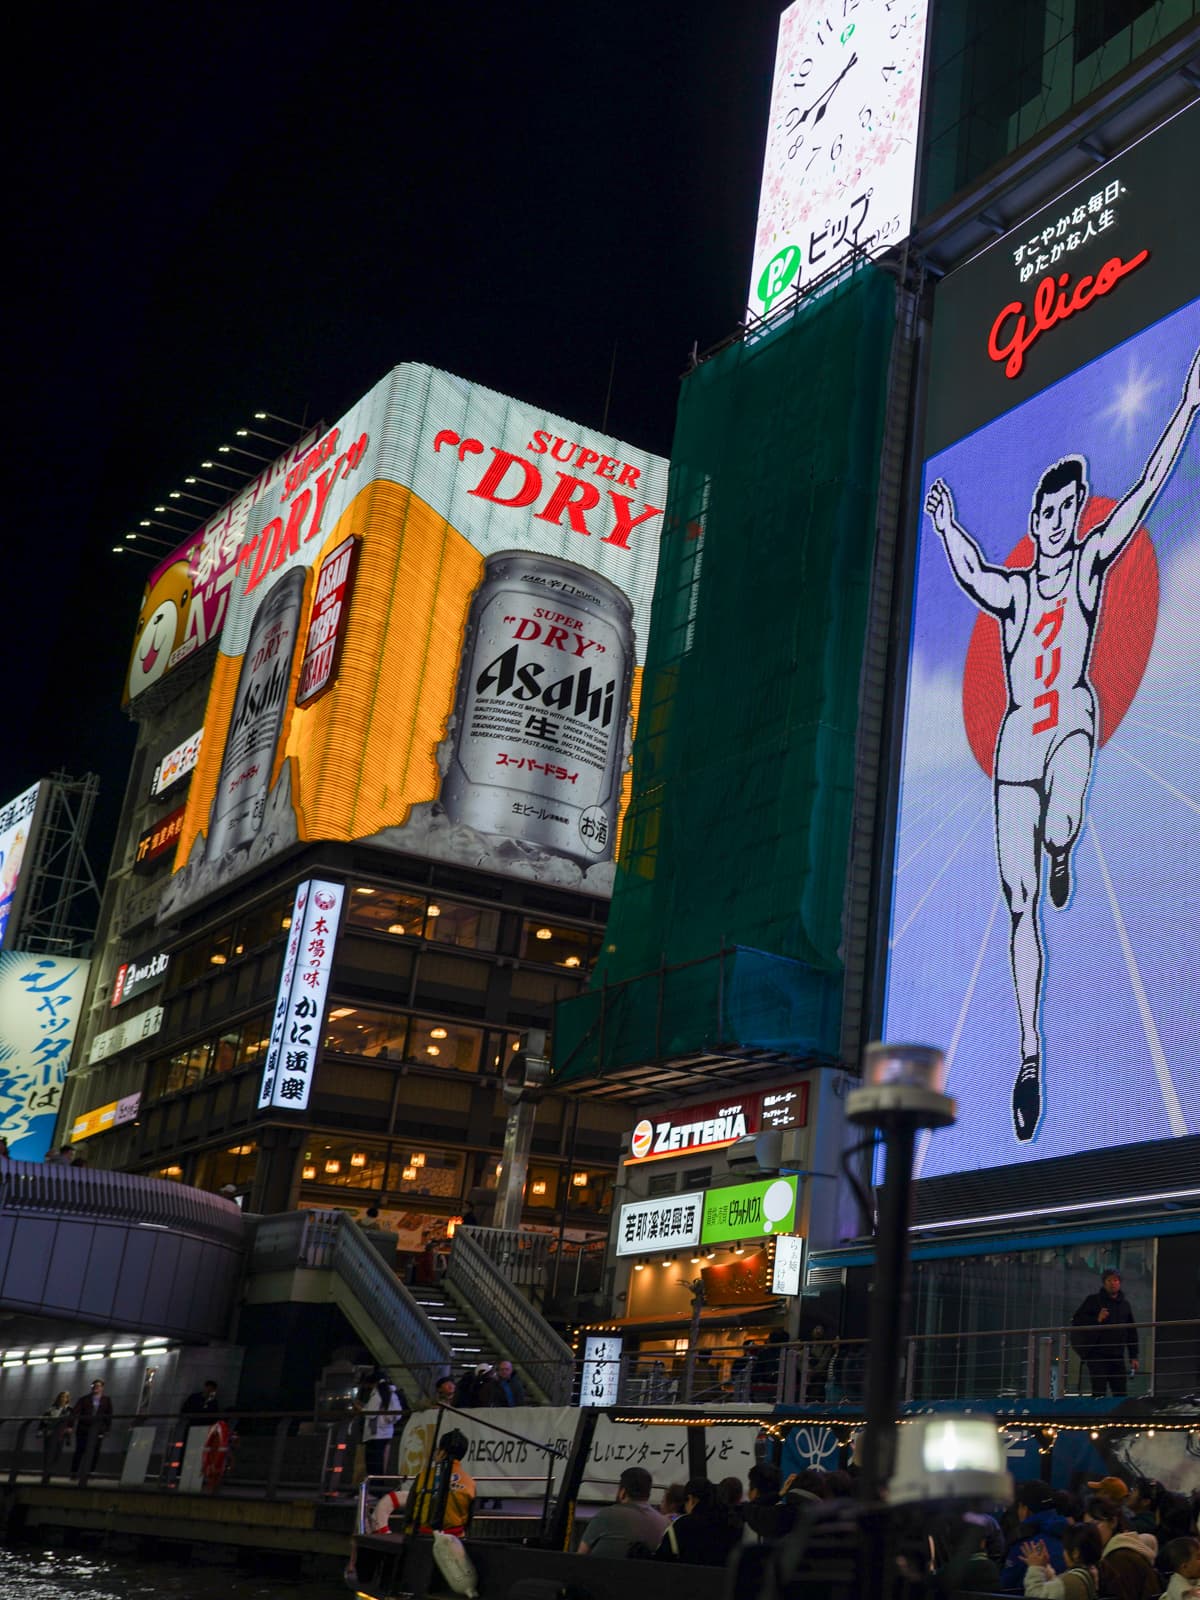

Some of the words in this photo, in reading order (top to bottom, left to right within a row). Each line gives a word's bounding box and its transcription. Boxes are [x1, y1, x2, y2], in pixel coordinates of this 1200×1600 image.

[858, 104, 872, 128] 5
[788, 135, 804, 160] 8
[831, 134, 843, 161] 6
[808, 187, 874, 265] ピップ
[1013, 180, 1127, 266] すこやかな毎日、
[1020, 209, 1116, 283] ゆたかな人生
[988, 250, 1149, 379] Glico
[279, 427, 340, 504] SUPER
[527, 429, 641, 490] SUPER
[308, 600, 343, 652] 1889
[533, 607, 584, 631] SUPER
[301, 642, 335, 693] OSAKA
[476, 644, 616, 728] Asahi
[1032, 597, 1067, 735] グリコ
[525, 714, 559, 745] 生
[496, 753, 579, 784] スーパードライ
[512, 802, 550, 821] 生ビール
[581, 816, 608, 845] お酒
[303, 916, 329, 989] 本場の味
[653, 1113, 746, 1154] ZETTERIA
[728, 1196, 761, 1227] ピタットハウス
[467, 1439, 528, 1463] RESORTS
